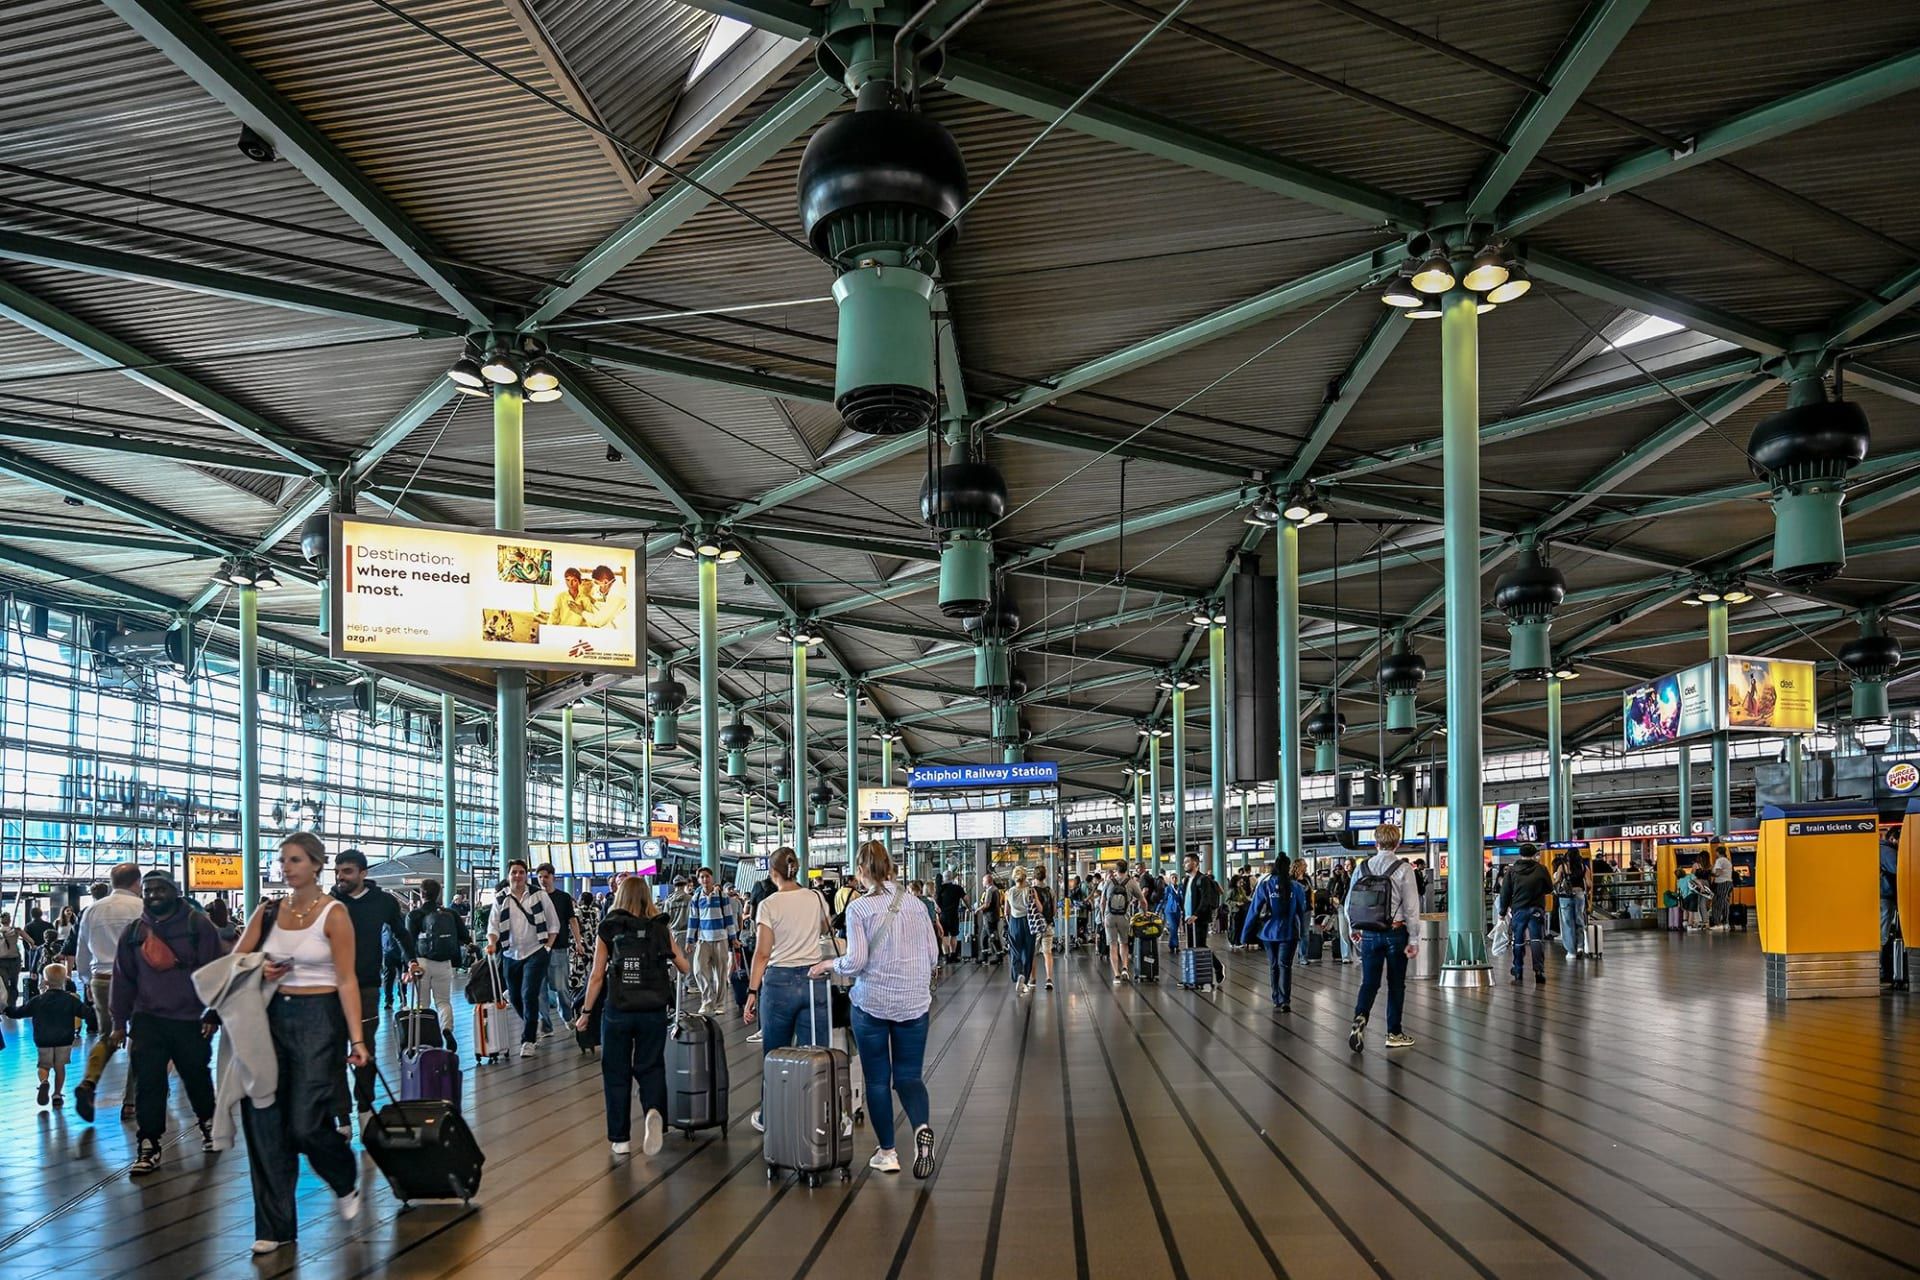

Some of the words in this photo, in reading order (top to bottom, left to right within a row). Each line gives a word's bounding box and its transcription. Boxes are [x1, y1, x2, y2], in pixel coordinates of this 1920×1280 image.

[357, 545, 454, 566] Destination:
[357, 564, 407, 579] where
[412, 571, 470, 584] needed
[357, 584, 403, 596] most.
[347, 624, 369, 632] Help
[403, 627, 429, 635] there
[346, 635, 376, 643] azg.nl
[914, 769, 961, 782] Schiphol
[965, 768, 1008, 779] Railway
[1012, 767, 1053, 777] Station
[1889, 768, 1915, 779] BURGER
[1890, 774, 1915, 787] KING
[1087, 823, 1102, 835] 3-4
[1621, 824, 1668, 837] BURGER
[1669, 822, 1703, 835] KIG
[1827, 823, 1852, 831] tickets
[624, 961, 640, 970] BER
